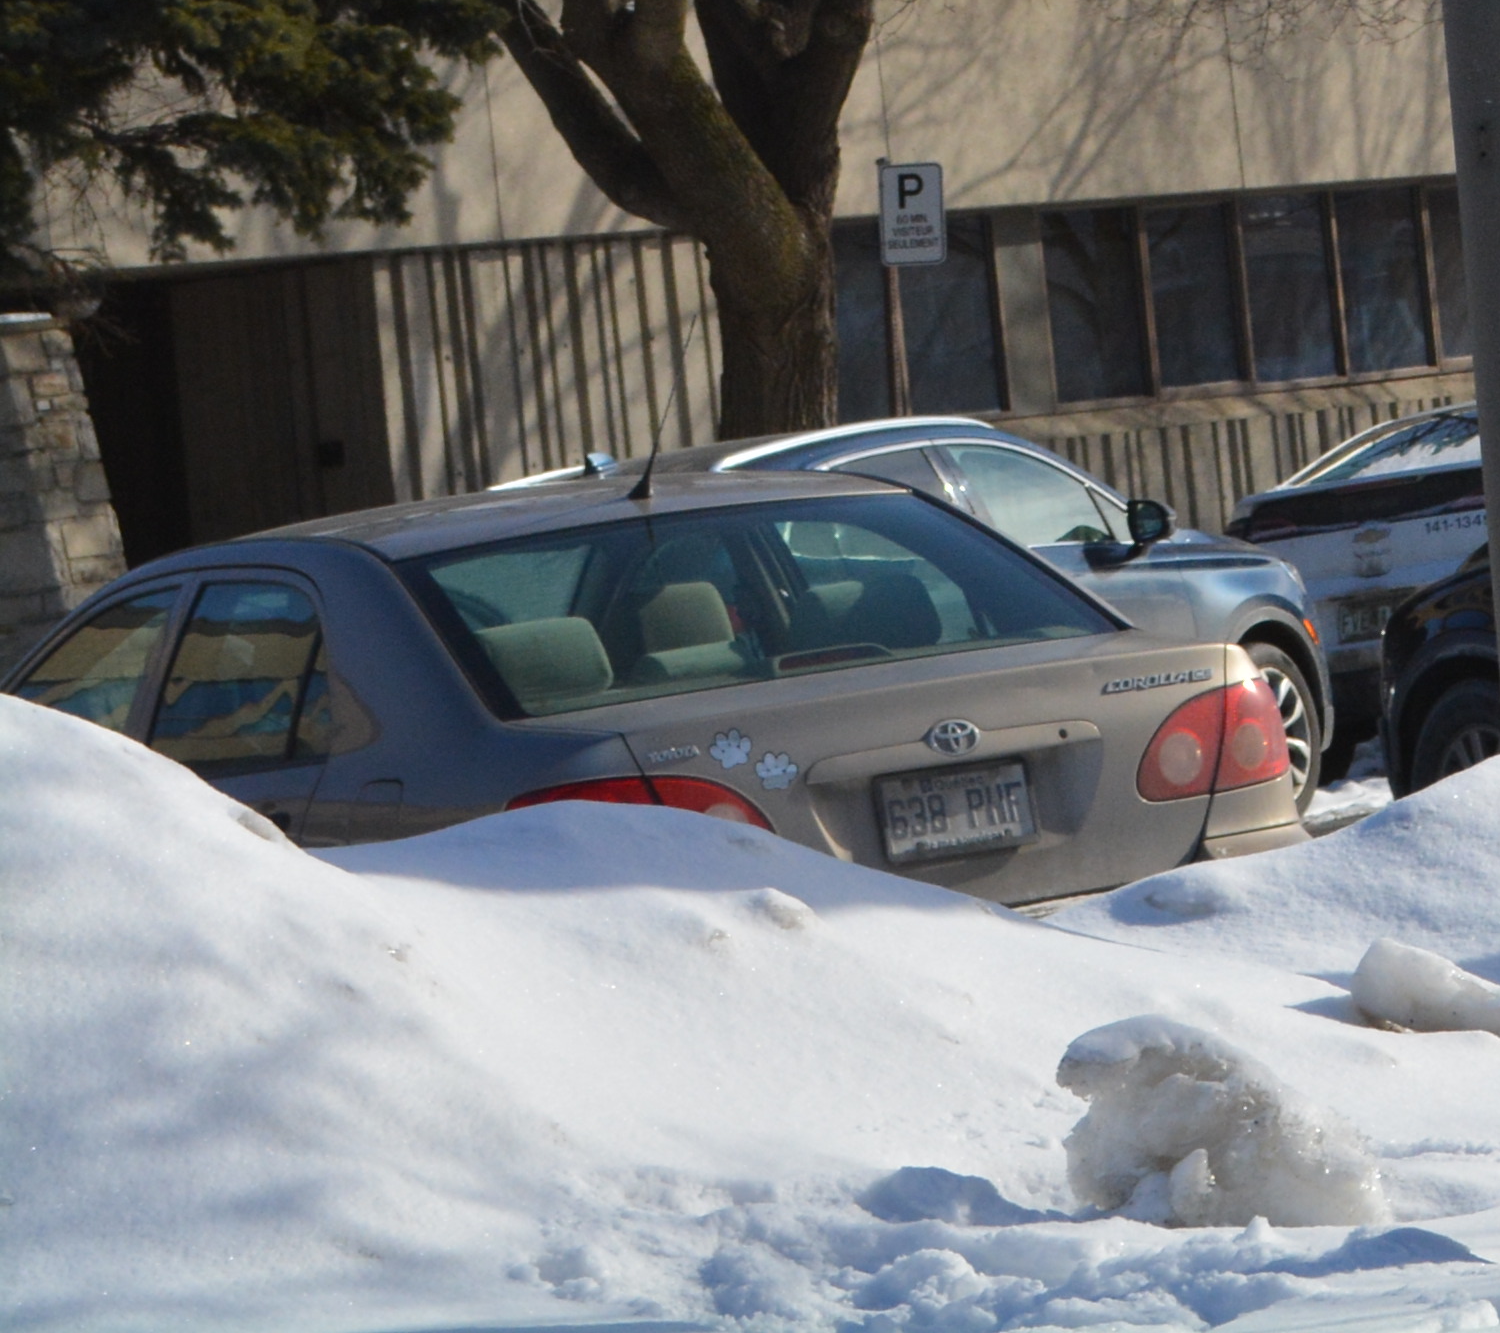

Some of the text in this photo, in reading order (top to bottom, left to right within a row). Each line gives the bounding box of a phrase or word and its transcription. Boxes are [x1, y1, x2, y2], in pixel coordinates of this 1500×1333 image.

[898, 174, 924, 209] P
[1425, 515, 1487, 534] 141-134
[1101, 671, 1191, 695] COROLLA
[649, 744, 700, 763] TOYOTA
[886, 793, 950, 840] 638
